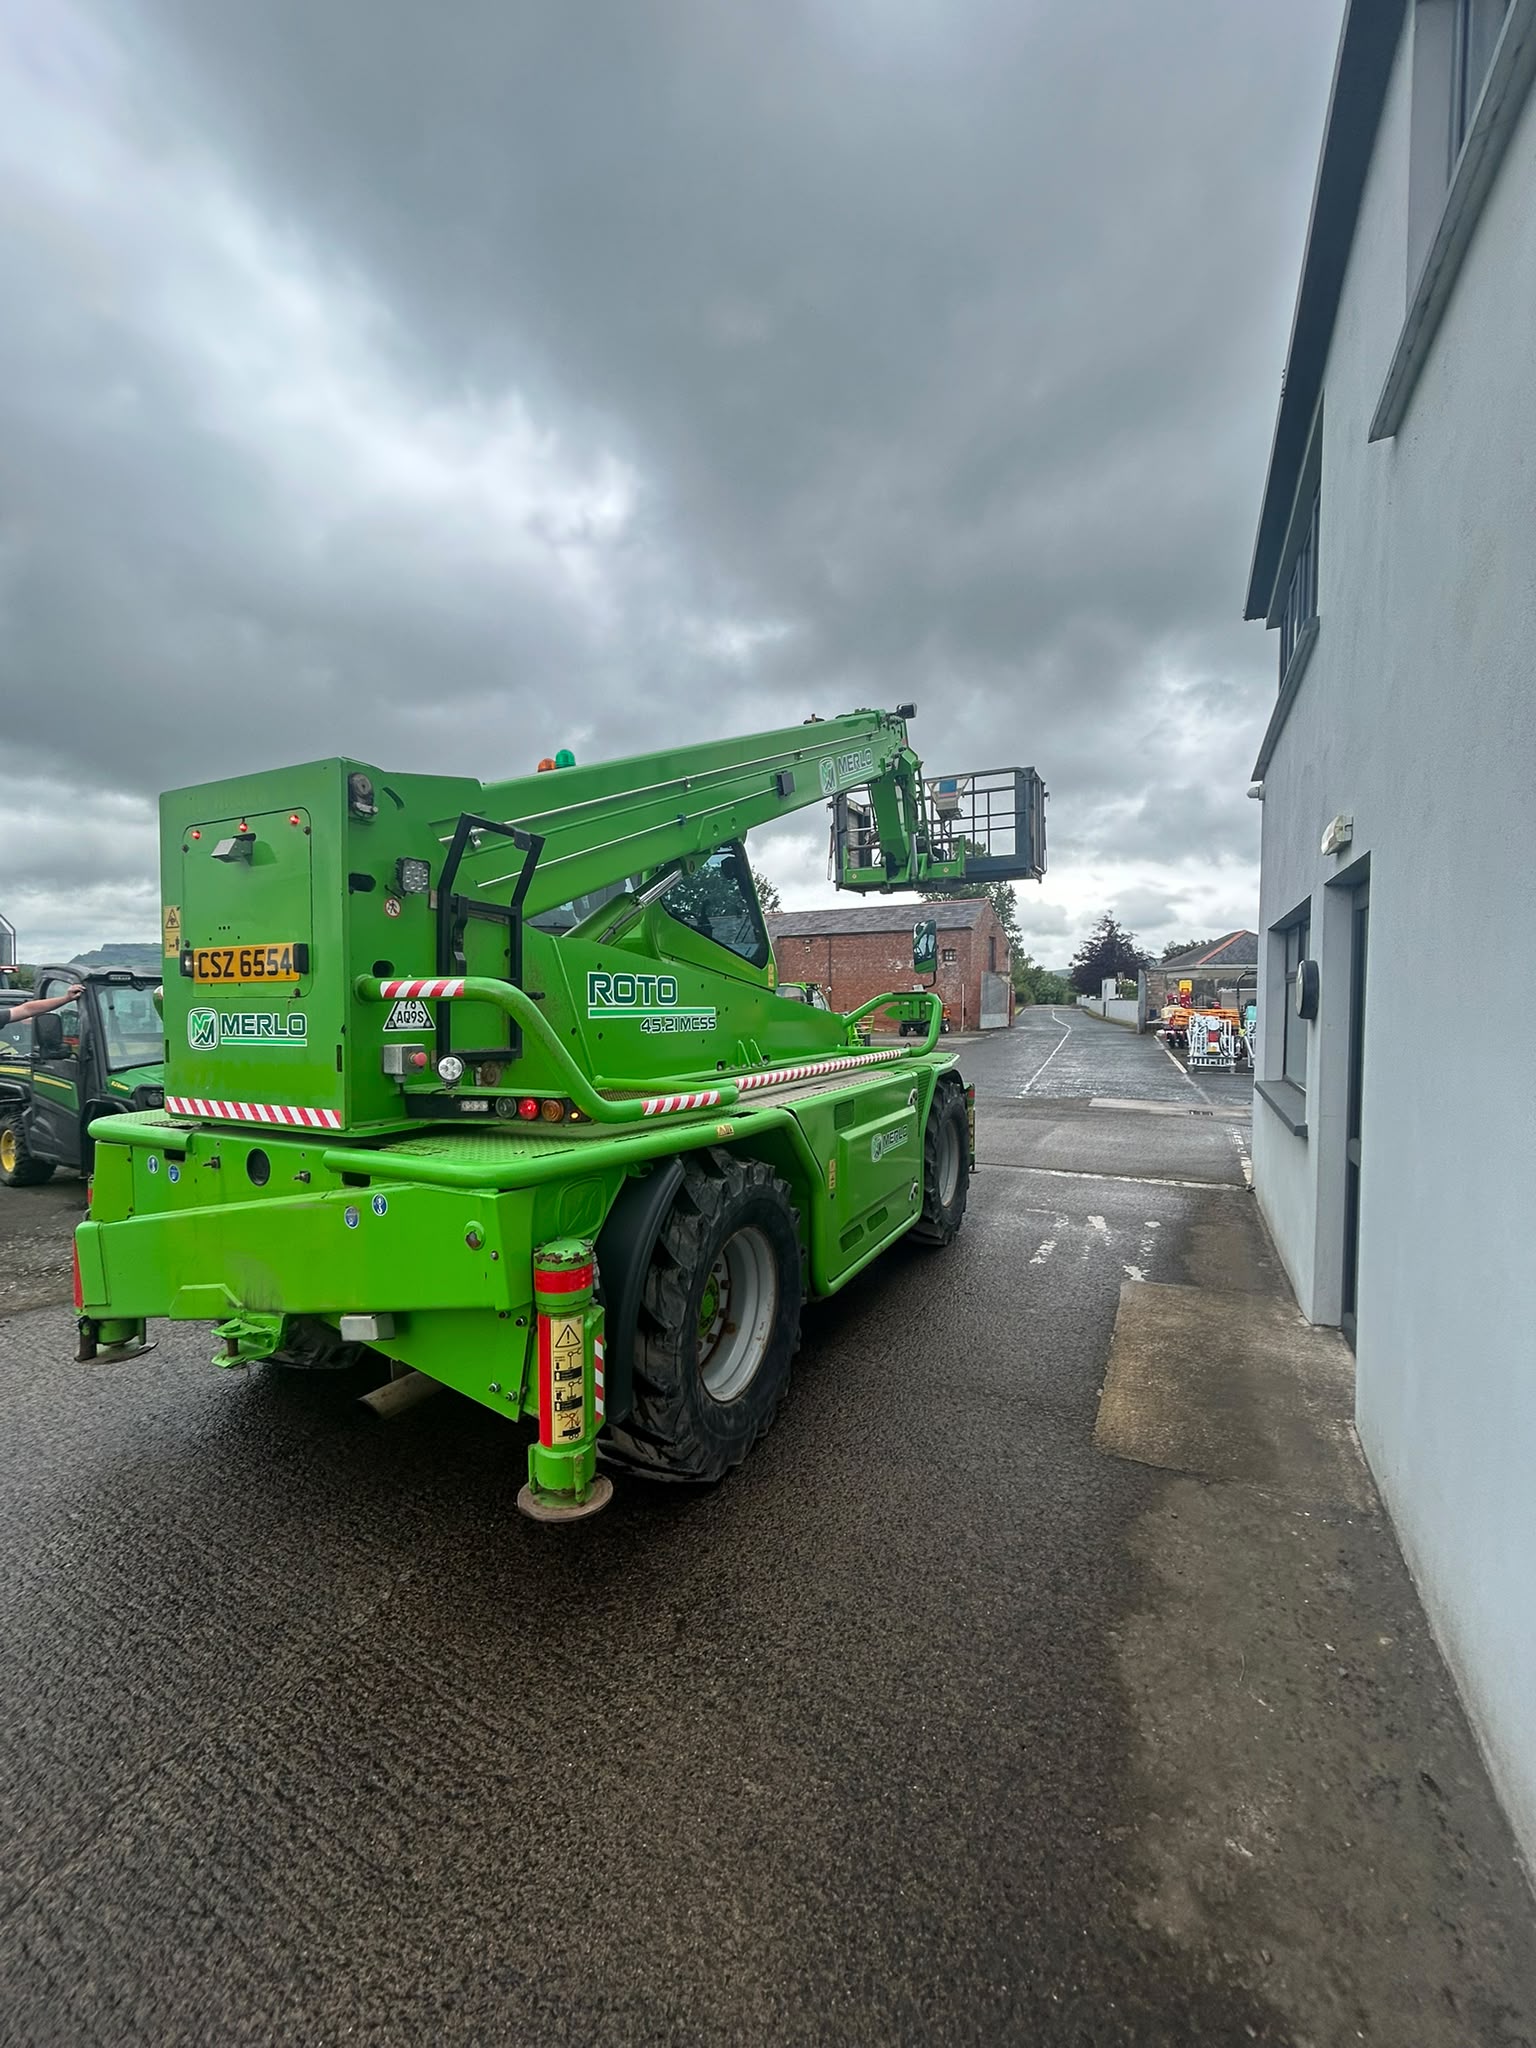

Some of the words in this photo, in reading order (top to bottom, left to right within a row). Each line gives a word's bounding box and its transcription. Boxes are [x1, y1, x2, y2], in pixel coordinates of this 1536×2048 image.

[837, 748, 872, 775] MERLO
[198, 951, 234, 978] CSZ
[240, 947, 292, 977] 6554
[587, 971, 678, 1006] ROTO
[220, 1012, 307, 1037] MERLO
[397, 1010, 424, 1023] AQ9S
